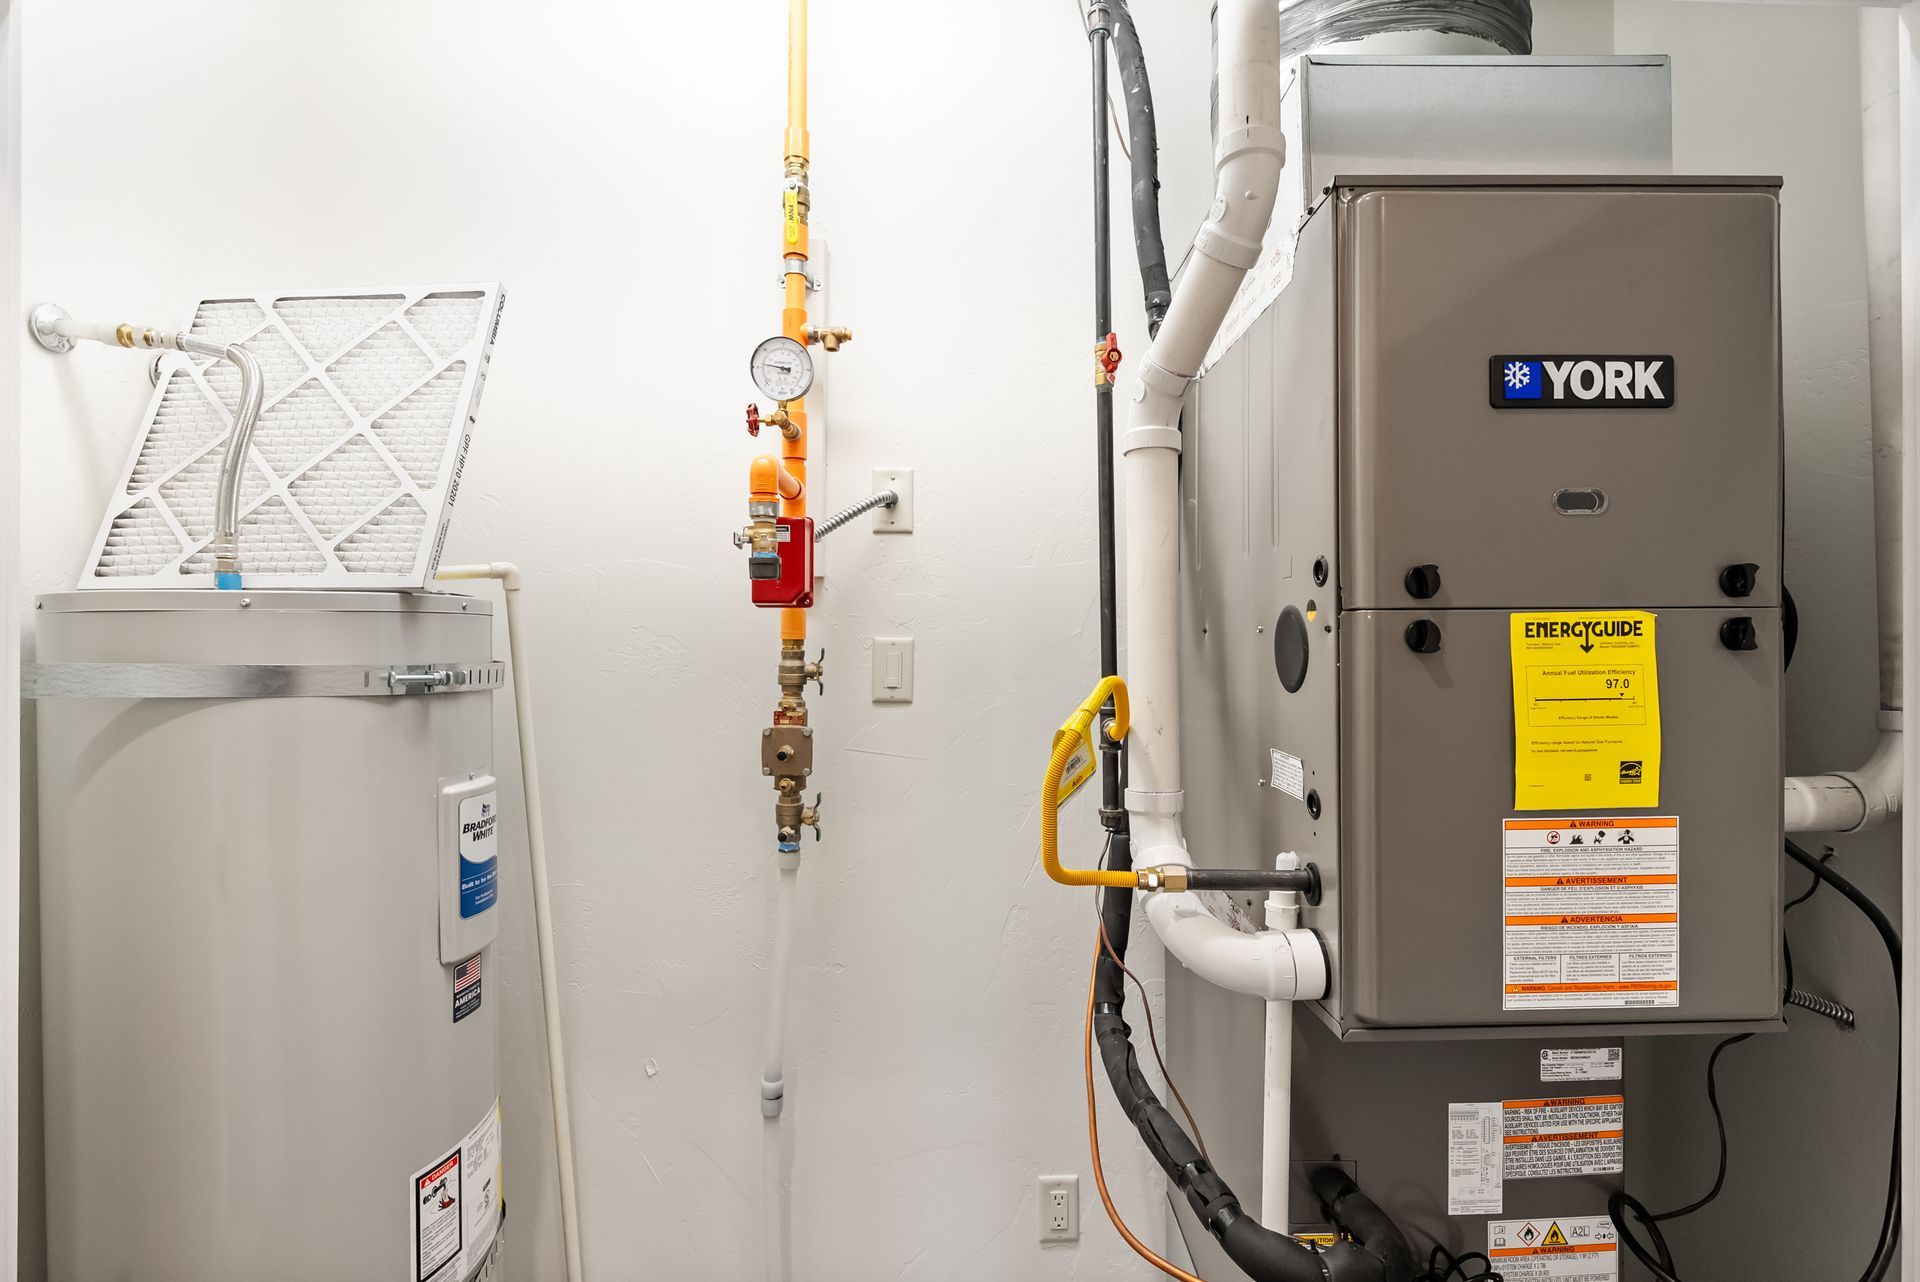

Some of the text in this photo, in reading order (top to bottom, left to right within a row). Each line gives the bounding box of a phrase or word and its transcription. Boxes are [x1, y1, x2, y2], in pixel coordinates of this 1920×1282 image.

[489, 293, 506, 346] COLUMBIA
[1542, 360, 1665, 400] YORK
[463, 434, 471, 454] GPF
[448, 478, 460, 508] 20201
[1525, 620, 1643, 639] ENERGYGUIDE
[1605, 679, 1629, 689] 97.0
[473, 826, 494, 841] WHITE
[455, 987, 480, 1008] AMERICA
[1539, 1132, 1598, 1141] AVERTISSEMENT
[431, 1161, 454, 1180] DANGER
[1572, 1227, 1589, 1237] A2L
[1540, 1246, 1575, 1254] WARNING
